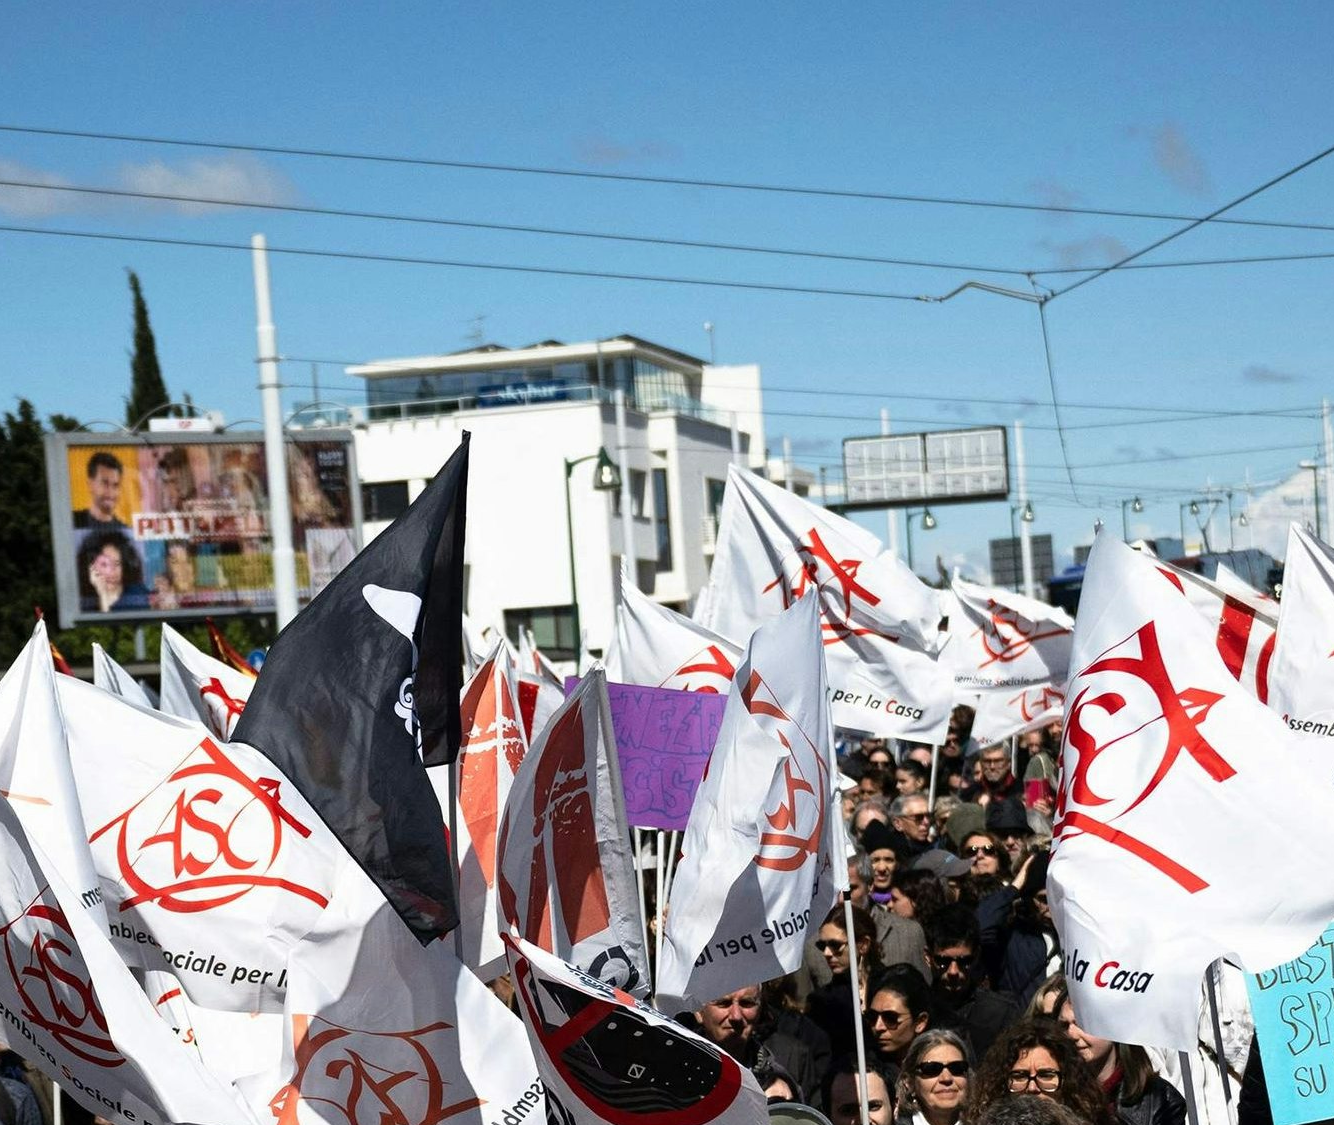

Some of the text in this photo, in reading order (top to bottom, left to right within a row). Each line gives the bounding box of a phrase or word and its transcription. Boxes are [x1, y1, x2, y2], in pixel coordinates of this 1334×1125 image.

[832, 689, 924, 720] per la Casa
[231, 966, 275, 988] per
[1072, 948, 1155, 994] la Casa
[60, 1064, 136, 1122] Sociale
[1295, 1064, 1327, 1099] SU
